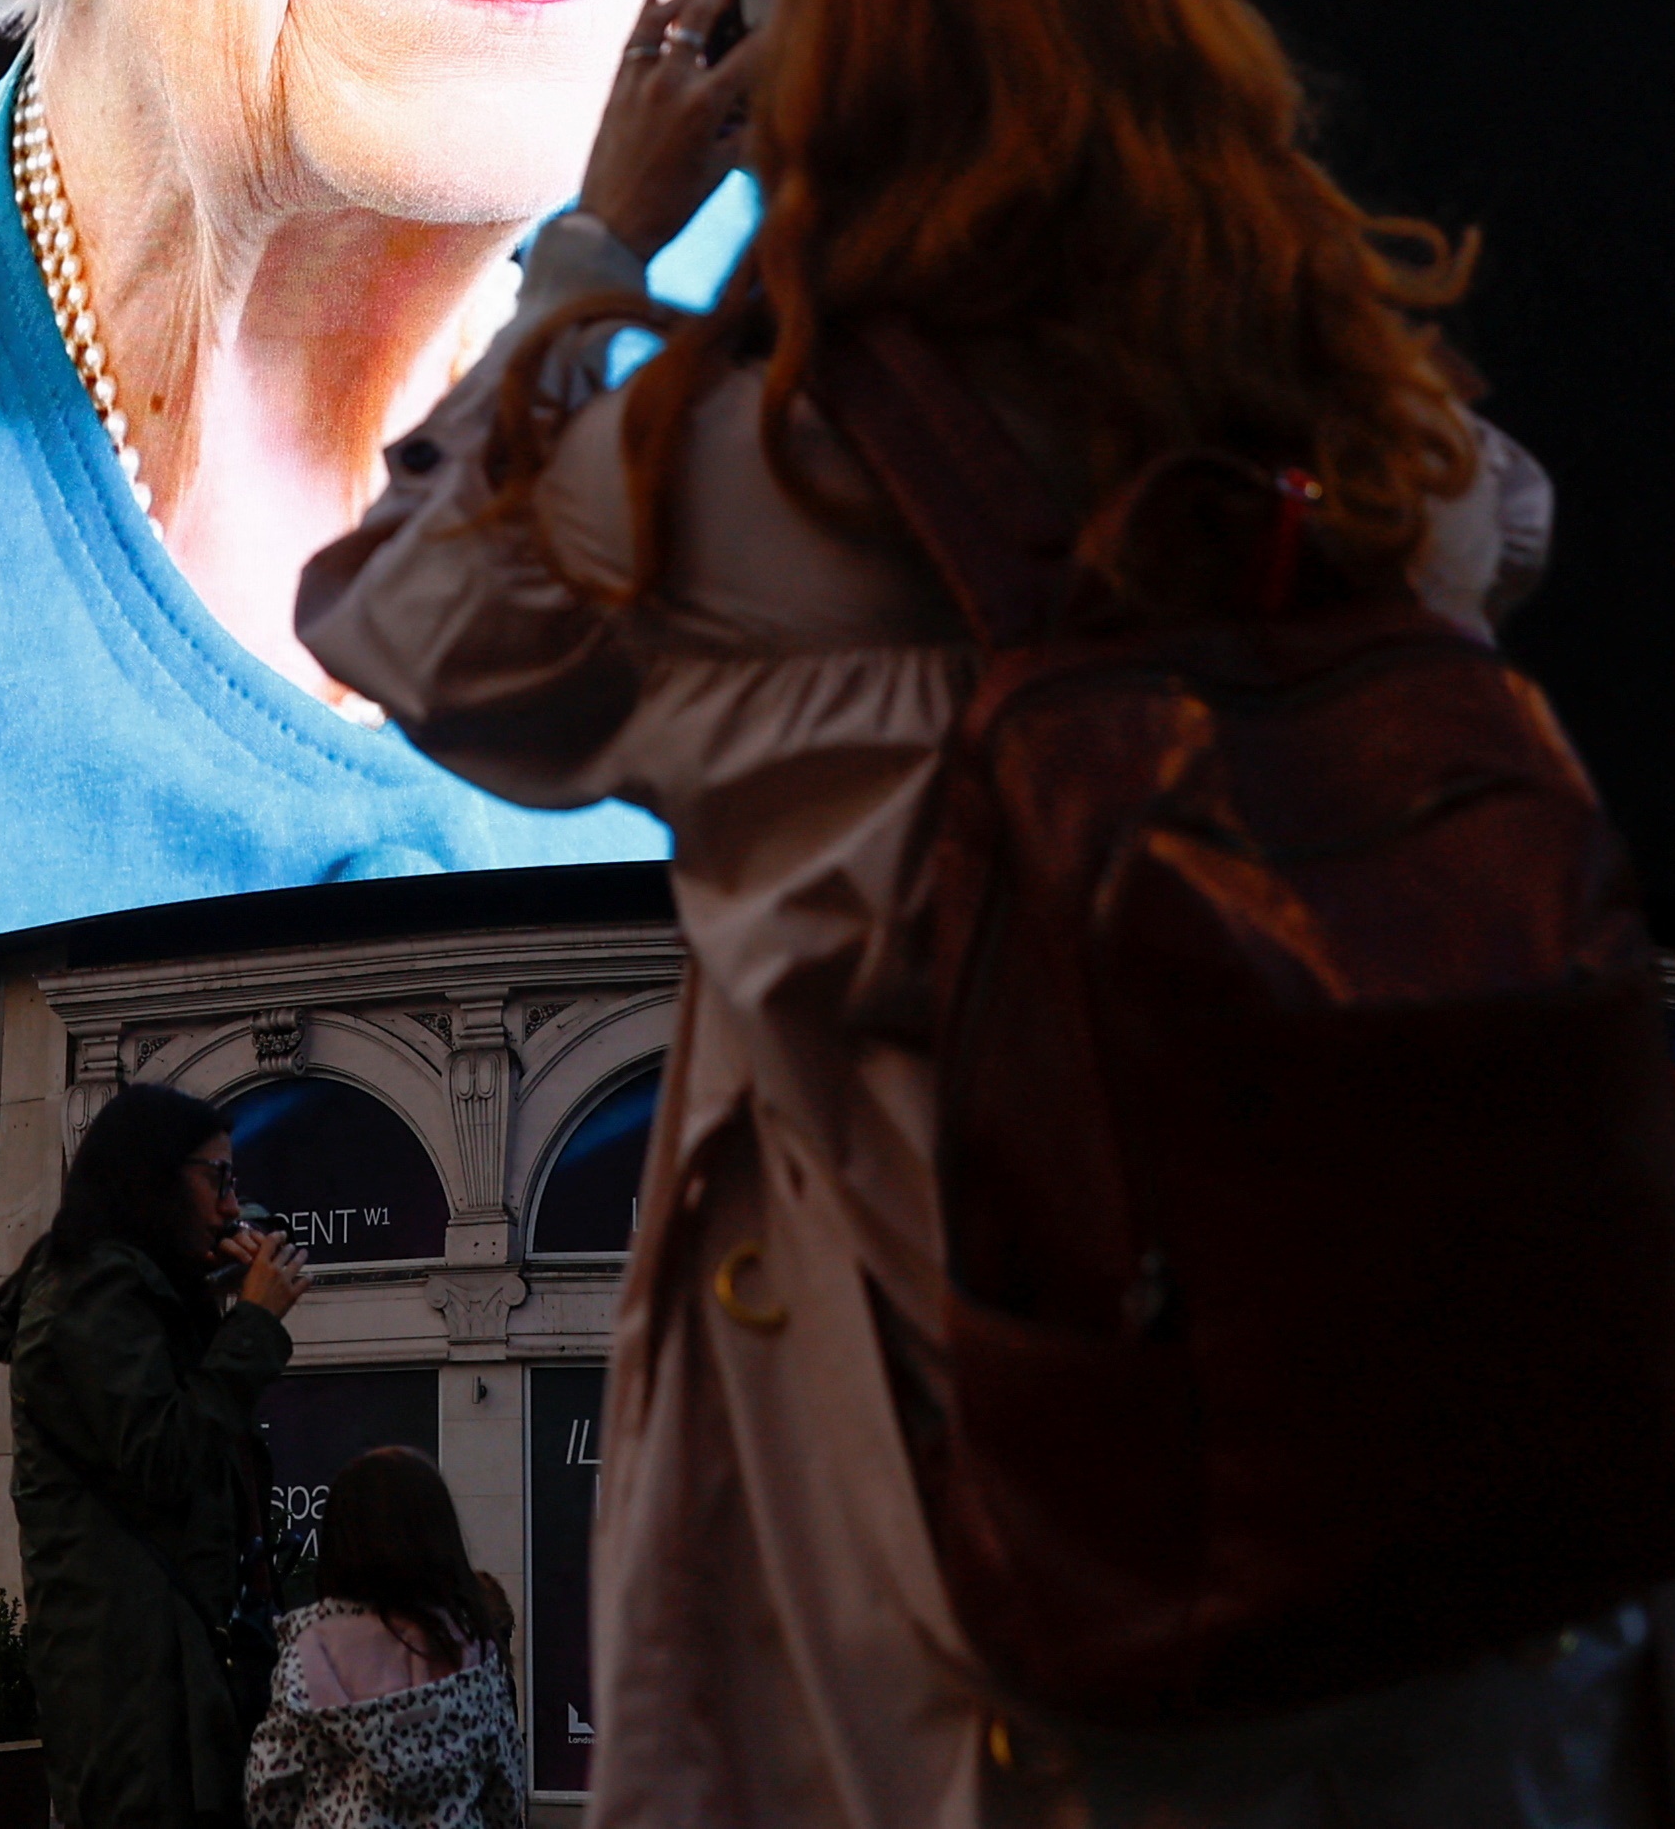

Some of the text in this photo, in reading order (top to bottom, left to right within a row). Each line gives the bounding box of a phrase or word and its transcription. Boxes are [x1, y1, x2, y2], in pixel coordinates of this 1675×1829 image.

[274, 1207, 391, 1247] ENT W1
[271, 1484, 330, 1530] spa
